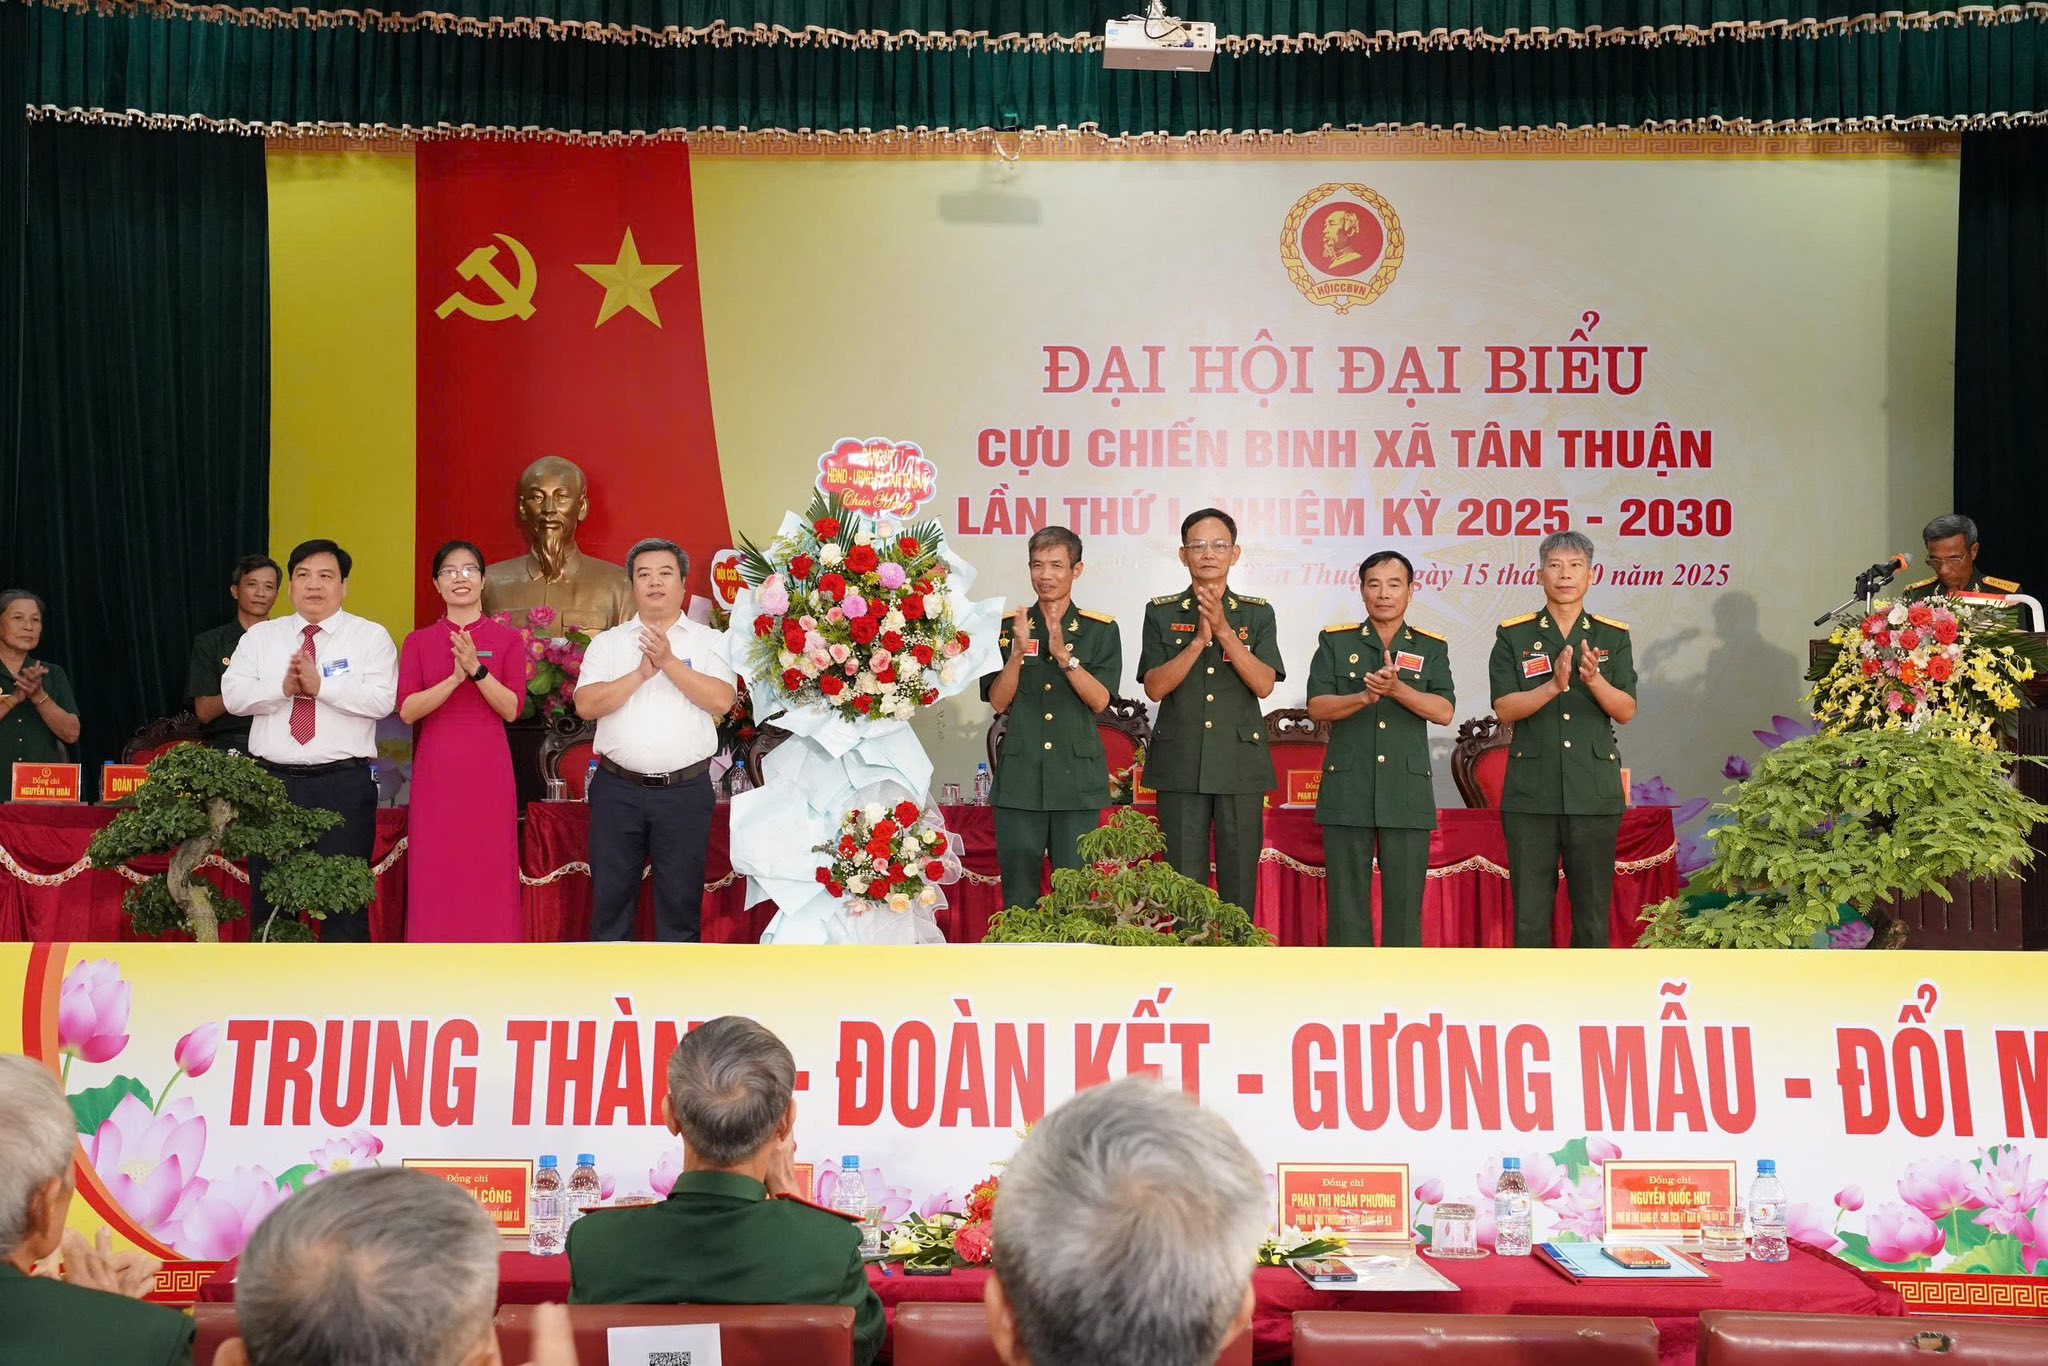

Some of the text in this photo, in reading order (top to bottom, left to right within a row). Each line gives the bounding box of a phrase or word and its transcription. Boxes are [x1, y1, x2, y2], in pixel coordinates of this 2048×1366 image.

[1042, 311, 1648, 408] ĐẠI HỘI ĐẠI BIỂU
[977, 417, 1712, 477] CỰU CHIẾN BINH XÃ TÂN THUẬN
[958, 484, 1047, 536] LẦN
[1063, 489, 1157, 536] THỨ
[1382, 490, 1442, 537] KỲ
[1456, 498, 1570, 537] 2025
[1618, 498, 1732, 537] 2030
[1301, 562, 1360, 592] Thuậ
[1412, 563, 1453, 592] gày
[1463, 563, 1490, 585] 15
[1610, 564, 1663, 586] năm
[1671, 563, 1730, 586] 2025
[226, 1018, 480, 1128] TRUNG
[835, 999, 1045, 1128] ĐOÀN
[1291, 1012, 1554, 1132] GƯƠNG
[1578, 980, 1757, 1134] MẪU
[1836, 983, 1974, 1138] ĐỔI
[481, 1187, 512, 1204] CÔNG
[1291, 1193, 1315, 1208] PHAN
[1334, 1191, 1357, 1208] NGÂN
[1630, 1186, 1711, 1206] NGUYỄN QUỐC HUY
